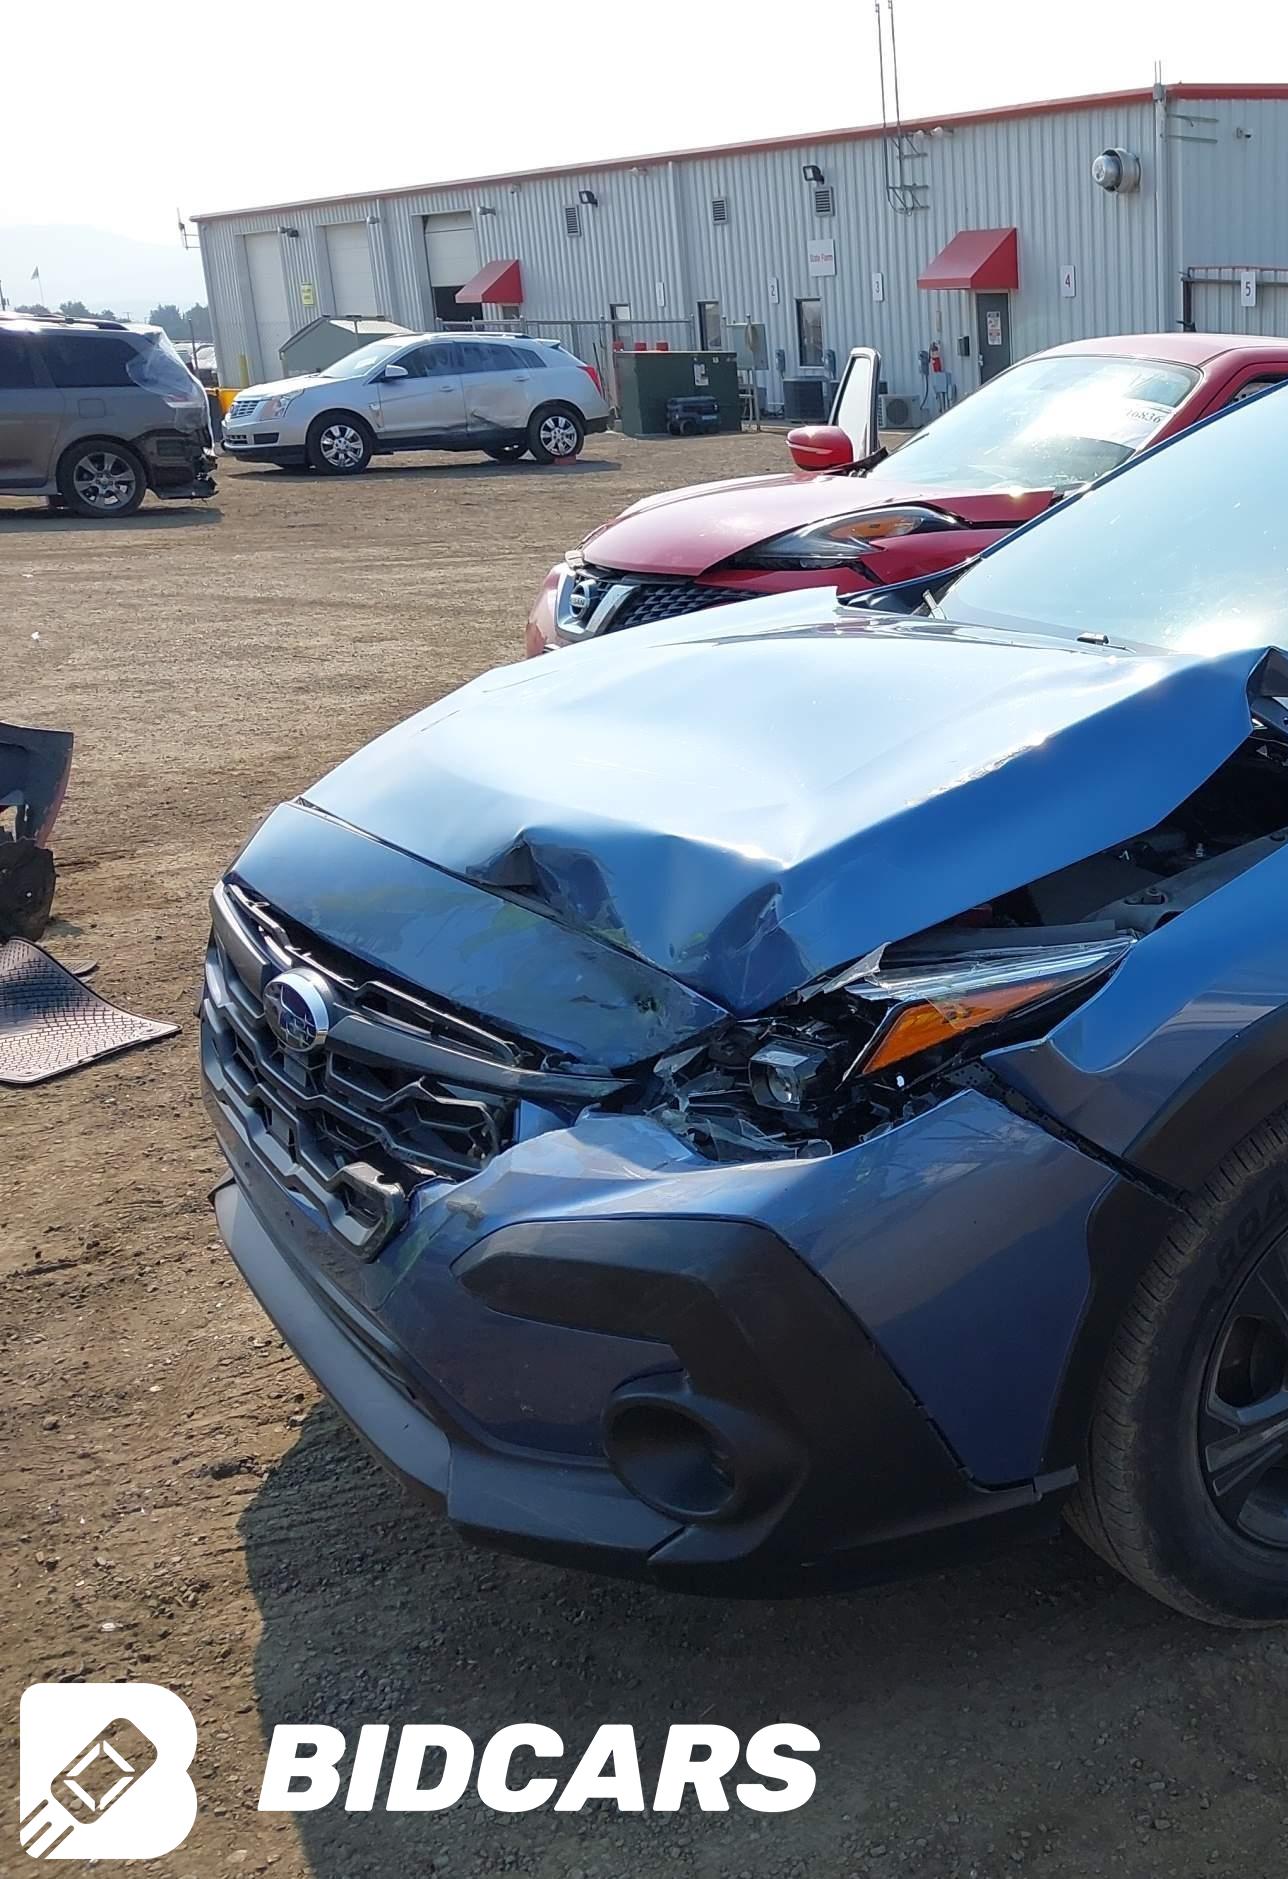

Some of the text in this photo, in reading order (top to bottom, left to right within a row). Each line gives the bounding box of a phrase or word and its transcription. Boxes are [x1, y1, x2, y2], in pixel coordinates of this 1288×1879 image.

[875, 280, 880, 293] 3
[1064, 273, 1071, 288] 4
[770, 284, 776, 297] 2
[1245, 281, 1251, 297] 5
